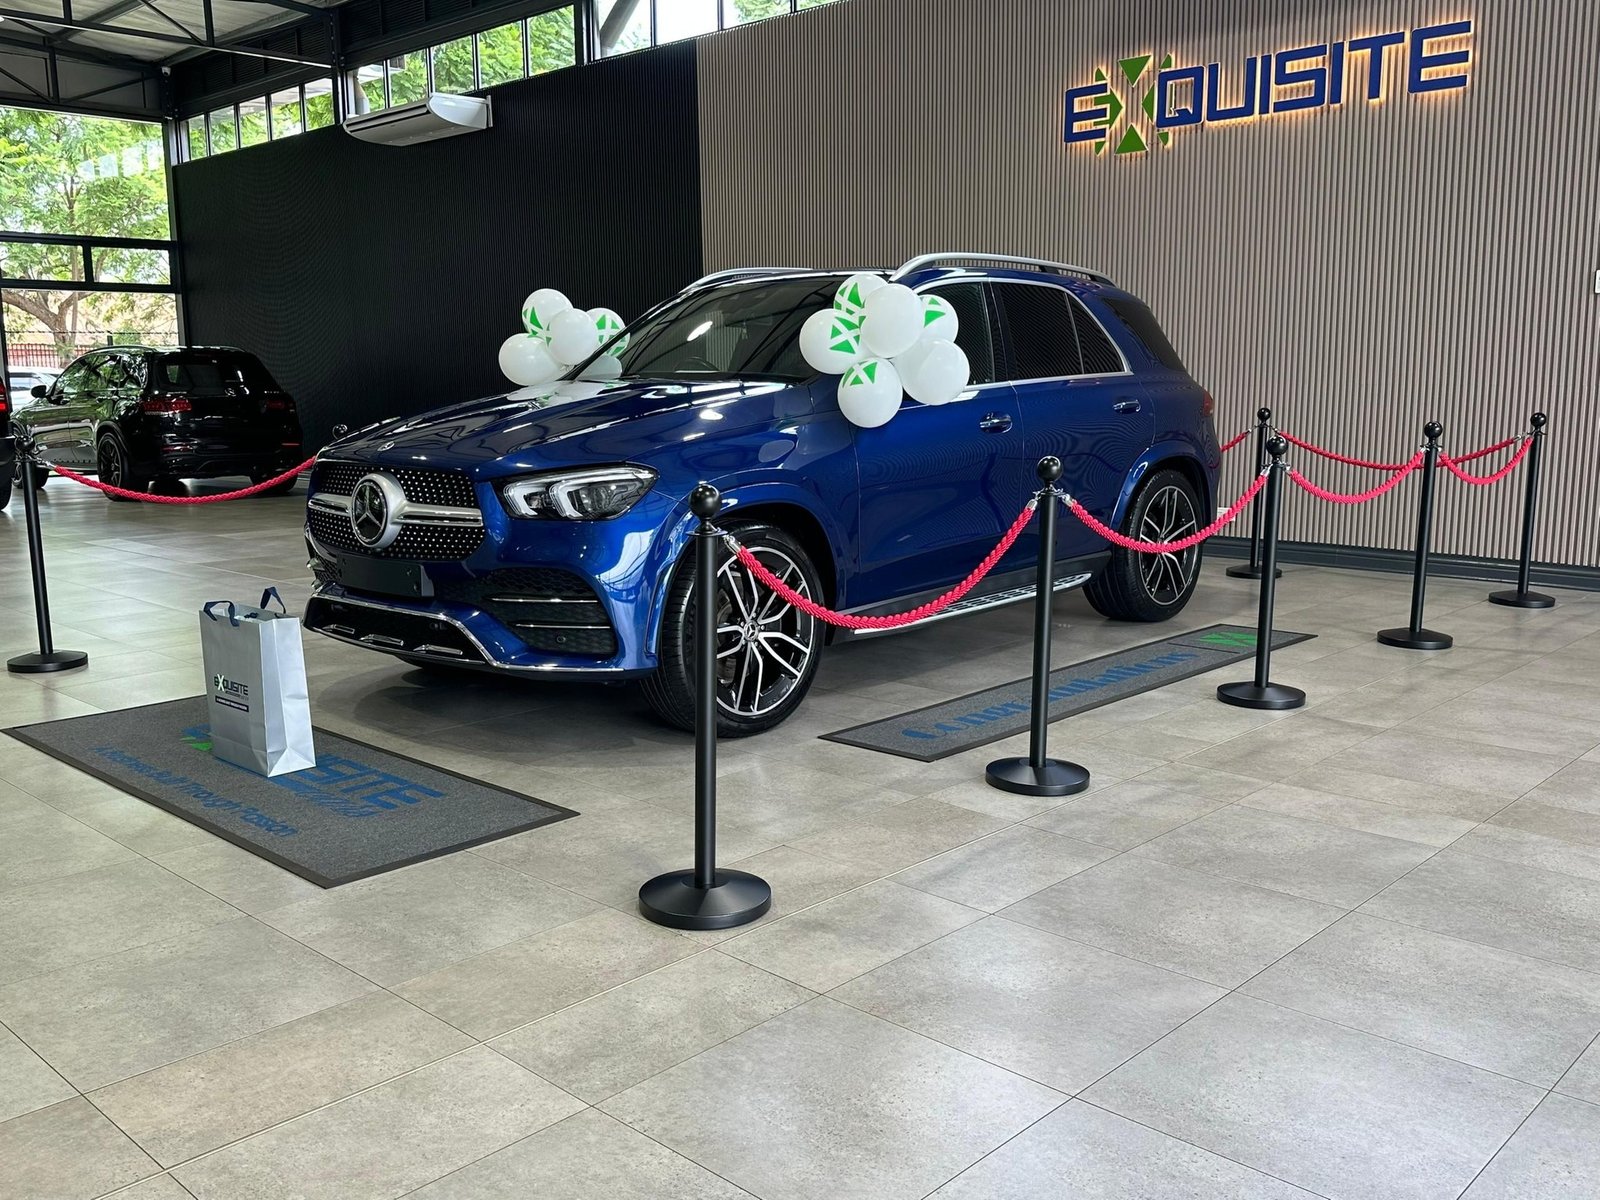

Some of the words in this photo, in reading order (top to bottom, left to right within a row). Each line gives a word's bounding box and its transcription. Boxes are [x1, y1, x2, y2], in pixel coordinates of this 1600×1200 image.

[1063, 20, 1472, 153] EXQUISITE
[214, 673, 249, 696] EXQUISITE
[902, 651, 1199, 741] Congrtulations
[236, 806, 298, 836] Passion
